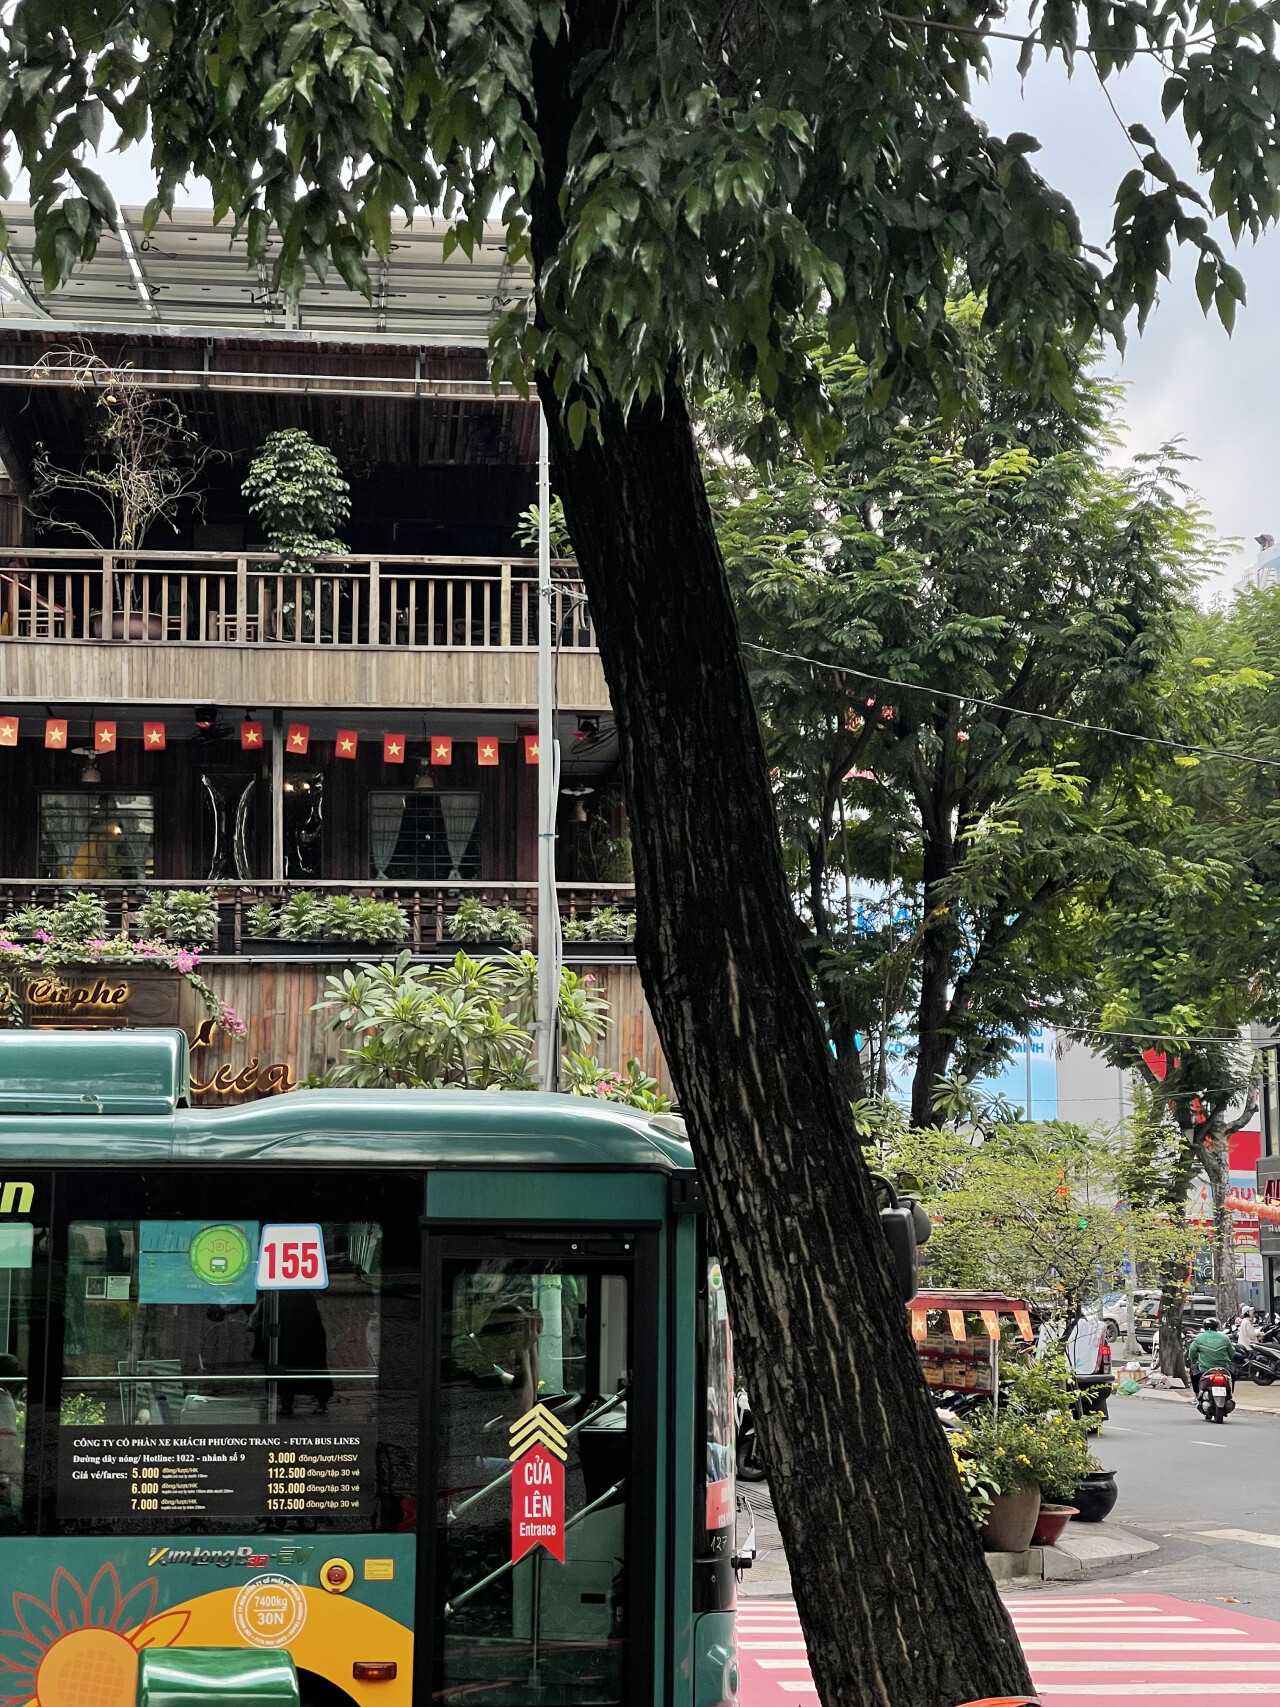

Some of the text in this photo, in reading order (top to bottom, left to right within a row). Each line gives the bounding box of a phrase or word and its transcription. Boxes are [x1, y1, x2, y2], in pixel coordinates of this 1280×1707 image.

[264, 1243, 318, 1279] 155
[73, 1438, 100, 1447] CÔNG
[102, 1438, 115, 1447] TY
[159, 1438, 171, 1446] XE
[173, 1436, 206, 1446] KHÁCH
[208, 1437, 247, 1446] PHƯƠNG
[249, 1438, 280, 1446] TRANG
[290, 1438, 313, 1446] FUTA
[315, 1438, 331, 1446] BUS
[334, 1438, 360, 1446] LINES
[143, 1454, 174, 1463] Hotline:
[177, 1454, 194, 1462] 1022
[202, 1453, 227, 1462] nhánh
[229, 1452, 238, 1462] số
[240, 1453, 246, 1462] 9
[268, 1452, 295, 1464] 3.000
[72, 1471, 88, 1480] Giá
[91, 1470, 128, 1480] vé/fares:
[132, 1467, 159, 1479] 5.000
[268, 1467, 305, 1479] 112.500
[341, 1469, 350, 1477] 30
[352, 1468, 360, 1477] vé
[524, 1455, 552, 1485] CỬA
[132, 1483, 158, 1494] 6.000
[268, 1483, 305, 1494] 135.000
[341, 1484, 350, 1492] 30
[351, 1484, 360, 1492] vé
[131, 1499, 158, 1510] 7.000
[267, 1499, 304, 1510] 157.500
[340, 1500, 350, 1508] 30
[351, 1500, 359, 1508] vé
[524, 1490, 552, 1518] LÊN
[520, 1522, 556, 1537] Entrance
[711, 1535, 728, 1552] 127
[255, 1595, 288, 1609] 7400kg
[257, 1612, 284, 1625] 30N
